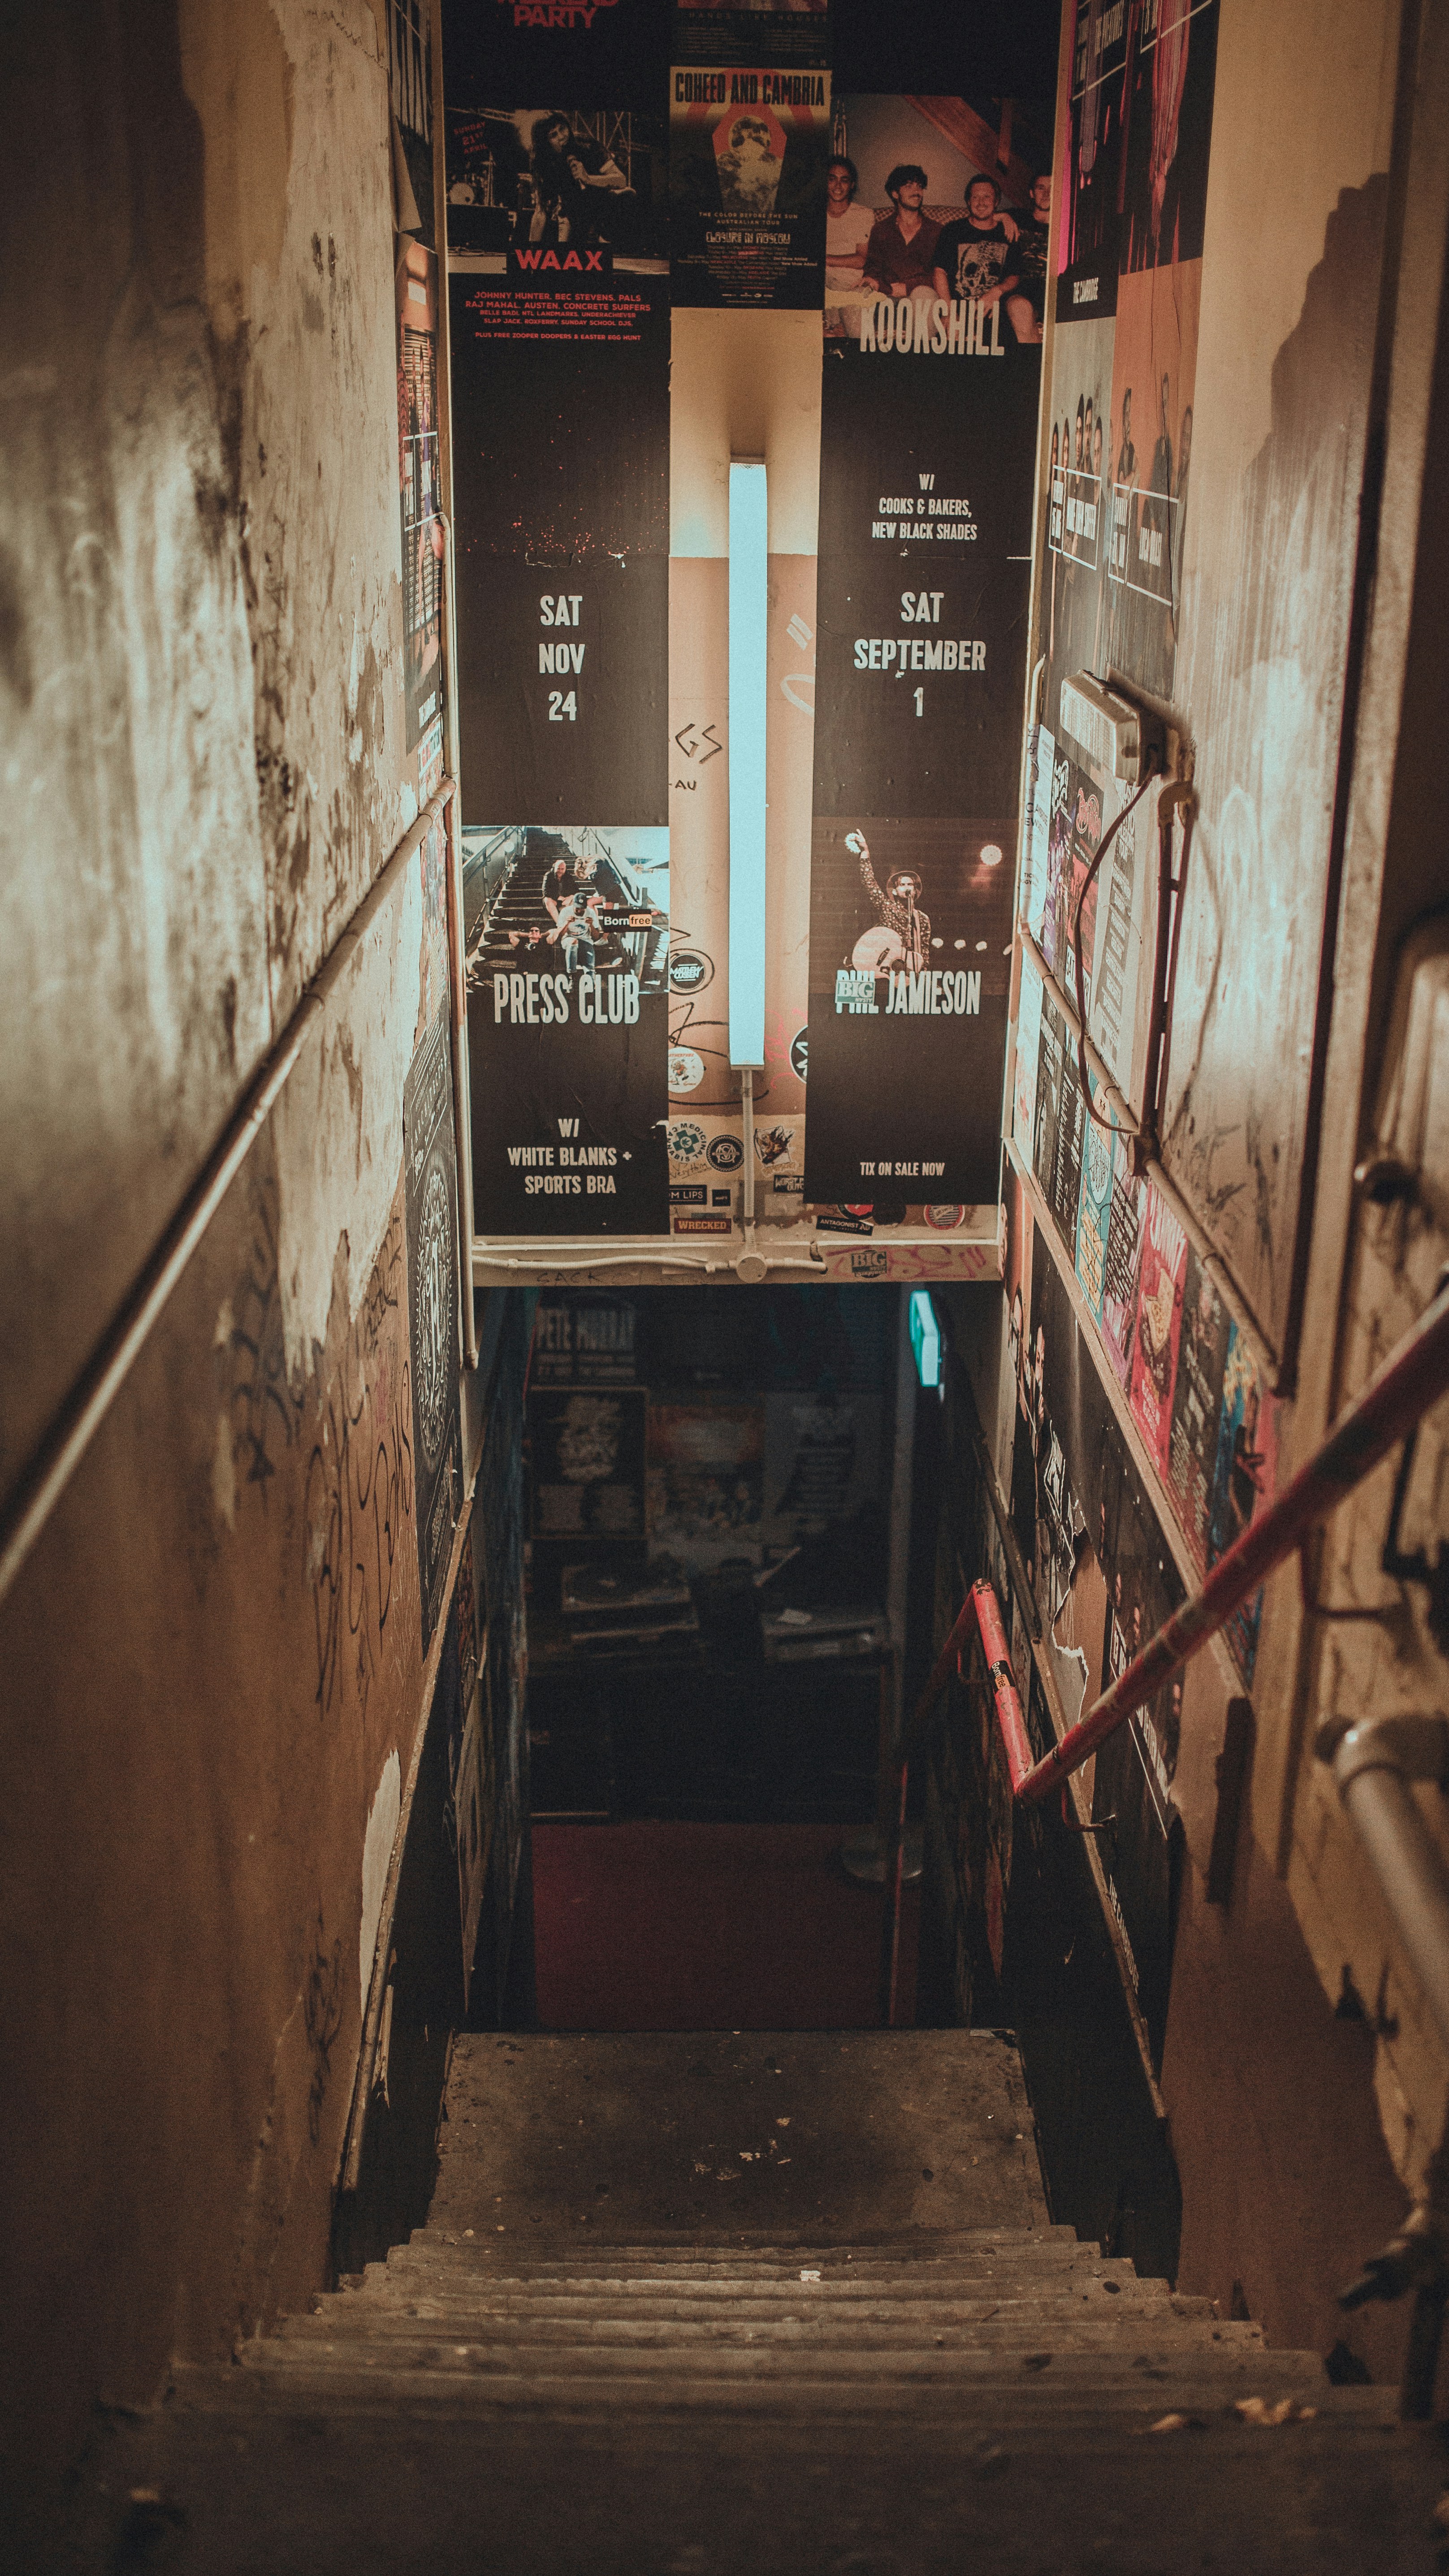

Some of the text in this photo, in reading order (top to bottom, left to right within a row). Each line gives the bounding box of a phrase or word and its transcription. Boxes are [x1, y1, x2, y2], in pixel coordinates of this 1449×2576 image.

[514, 5, 598, 28] PARTY
[675, 73, 825, 106] COHEED AND CAMBRIA
[706, 232, 742, 242] CLOSURE
[756, 233, 791, 244] MOSCOW
[515, 249, 603, 270] WAAX
[859, 298, 1005, 355] KOOKSHILL
[879, 497, 972, 518] COOKS & BAKERS,
[872, 522, 977, 540] NEW BLACK SHADES
[540, 596, 583, 626] SAT
[900, 592, 944, 623] SAT
[539, 644, 585, 674] NOV
[854, 639, 986, 671] SEPTEMBER
[549, 691, 577, 721] 24
[913, 687, 924, 717] 1
[1067, 952, 1075, 985] SAT
[493, 973, 640, 1024] PRESS CLUB
[837, 982, 874, 998] BIG
[885, 971, 981, 1014] JAMIESON
[667, 1127, 690, 1162] CANNABIS
[680, 1123, 707, 1158] MEDICINAL
[507, 1147, 554, 1166] WHITE
[560, 1147, 617, 1166] BLANKS
[860, 1162, 945, 1176] TIX ON SALE NOW
[525, 1175, 616, 1194] SPORTS BRA
[679, 1220, 727, 1230] WRECKED
[820, 1219, 859, 1229] ANTAGONIST
[852, 1251, 886, 1267] BIG
